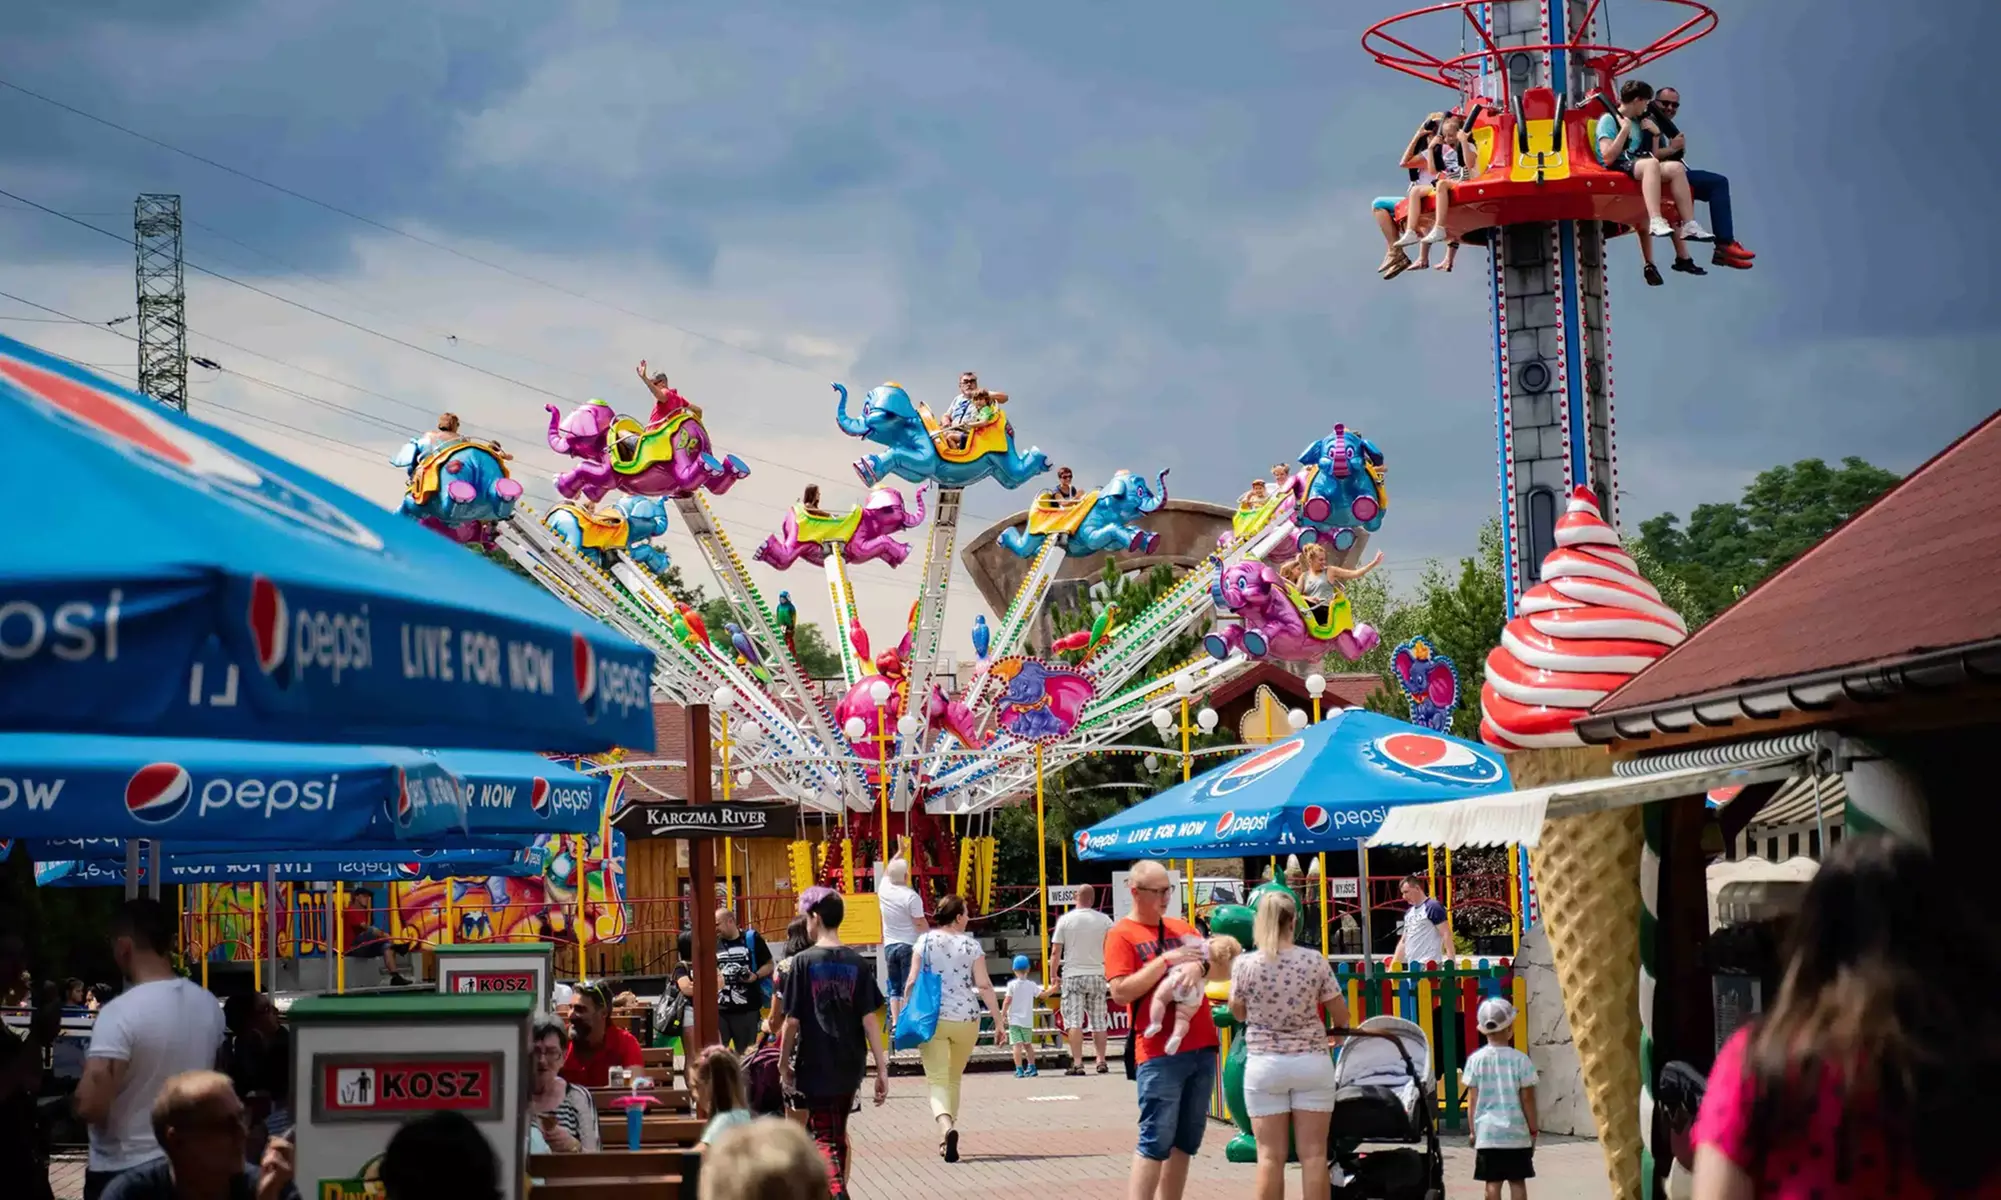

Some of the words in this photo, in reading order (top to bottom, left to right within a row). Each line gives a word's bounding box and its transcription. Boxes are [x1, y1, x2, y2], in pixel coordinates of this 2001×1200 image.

[295, 604, 373, 685] pepsi
[401, 623, 454, 682] LIVE
[460, 630, 503, 688] FOR
[507, 640, 554, 695] NOW
[599, 658, 647, 718] pepsi
[199, 773, 340, 819] pepsi
[480, 784, 517, 809] NOW
[551, 785, 592, 818] pepsi
[646, 808, 718, 825] KARCZMA
[721, 807, 767, 824] RIVER
[1089, 829, 1119, 849] pepsi
[1127, 830, 1151, 844] LIVE
[1154, 824, 1175, 840] FOR
[1178, 820, 1207, 837] NOW
[1232, 812, 1271, 836] pepsi
[1334, 805, 1387, 829] pepsi
[480, 977, 528, 993] KOSZ
[382, 1071, 482, 1099] KOSZ
